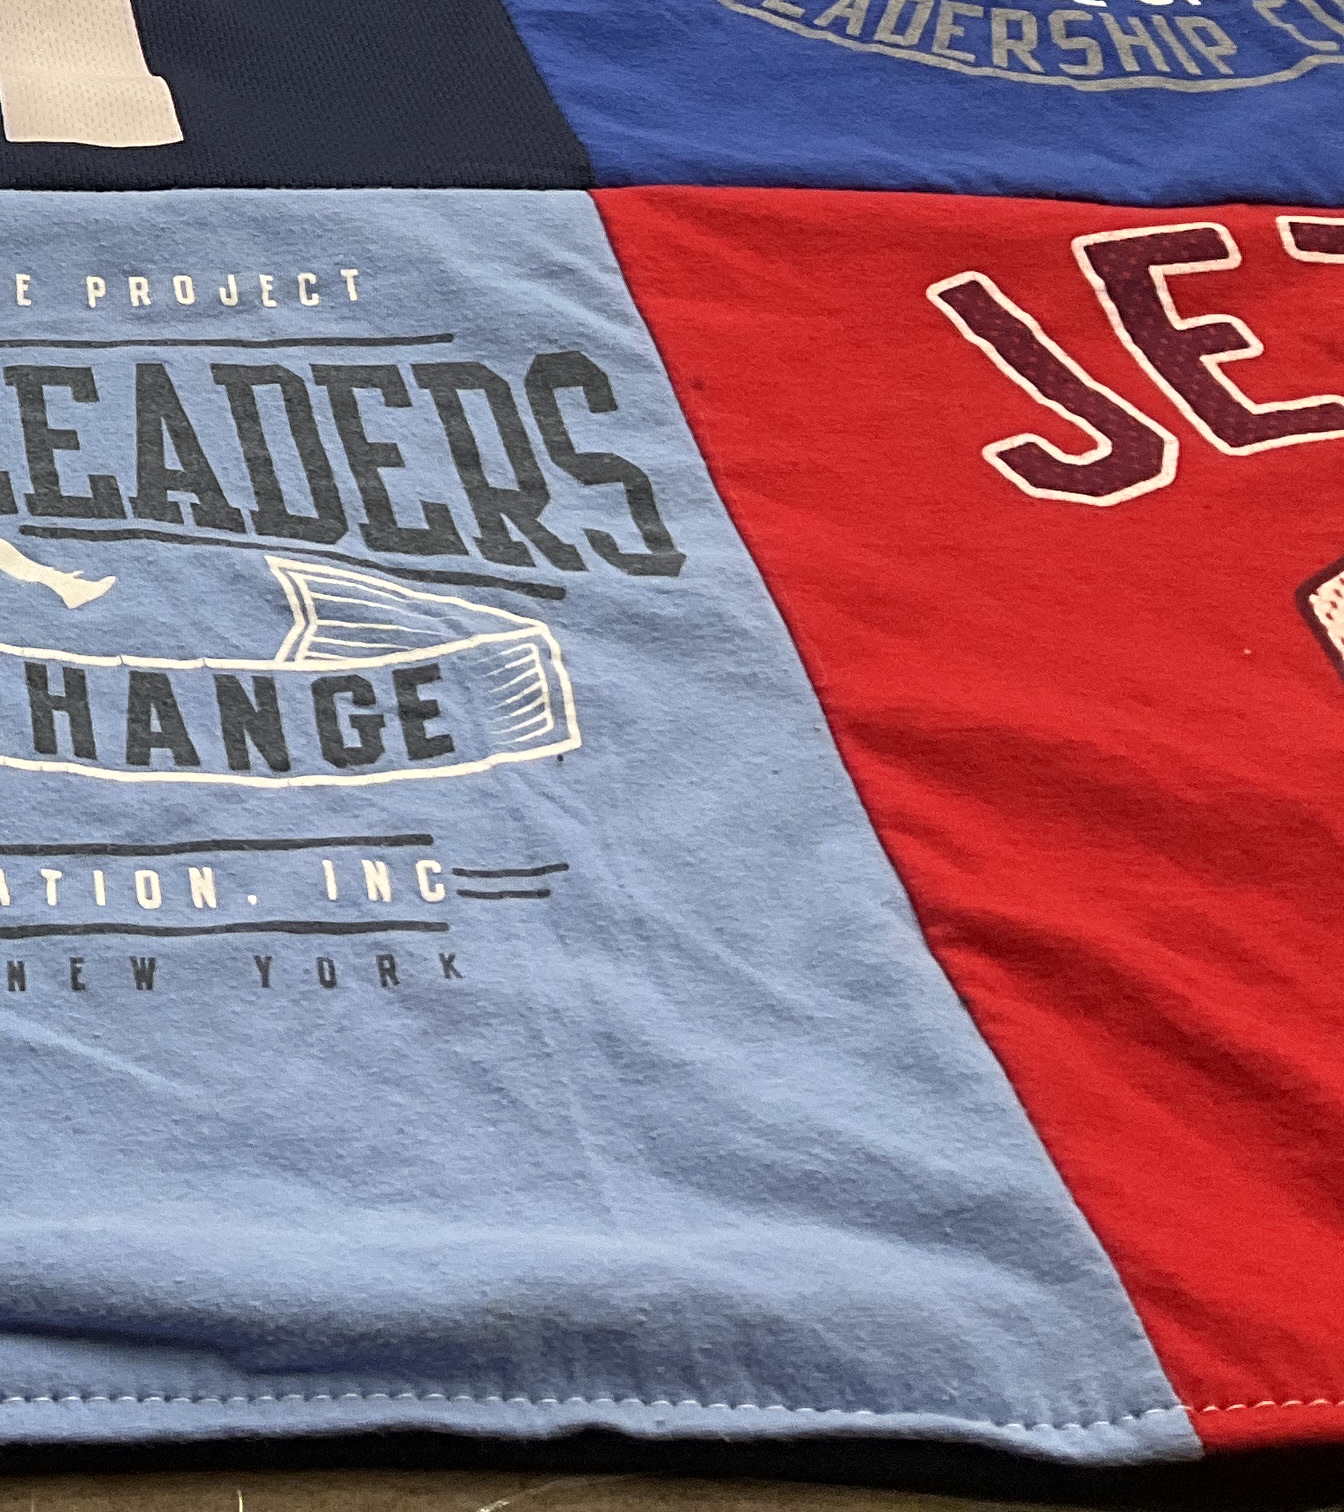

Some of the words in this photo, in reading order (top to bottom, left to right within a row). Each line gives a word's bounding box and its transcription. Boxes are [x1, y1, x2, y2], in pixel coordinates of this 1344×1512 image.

[84, 267, 362, 308] PROJECT
[320, 857, 448, 906] INC
[6, 955, 158, 993] NEW
[254, 952, 465, 989] YORK
